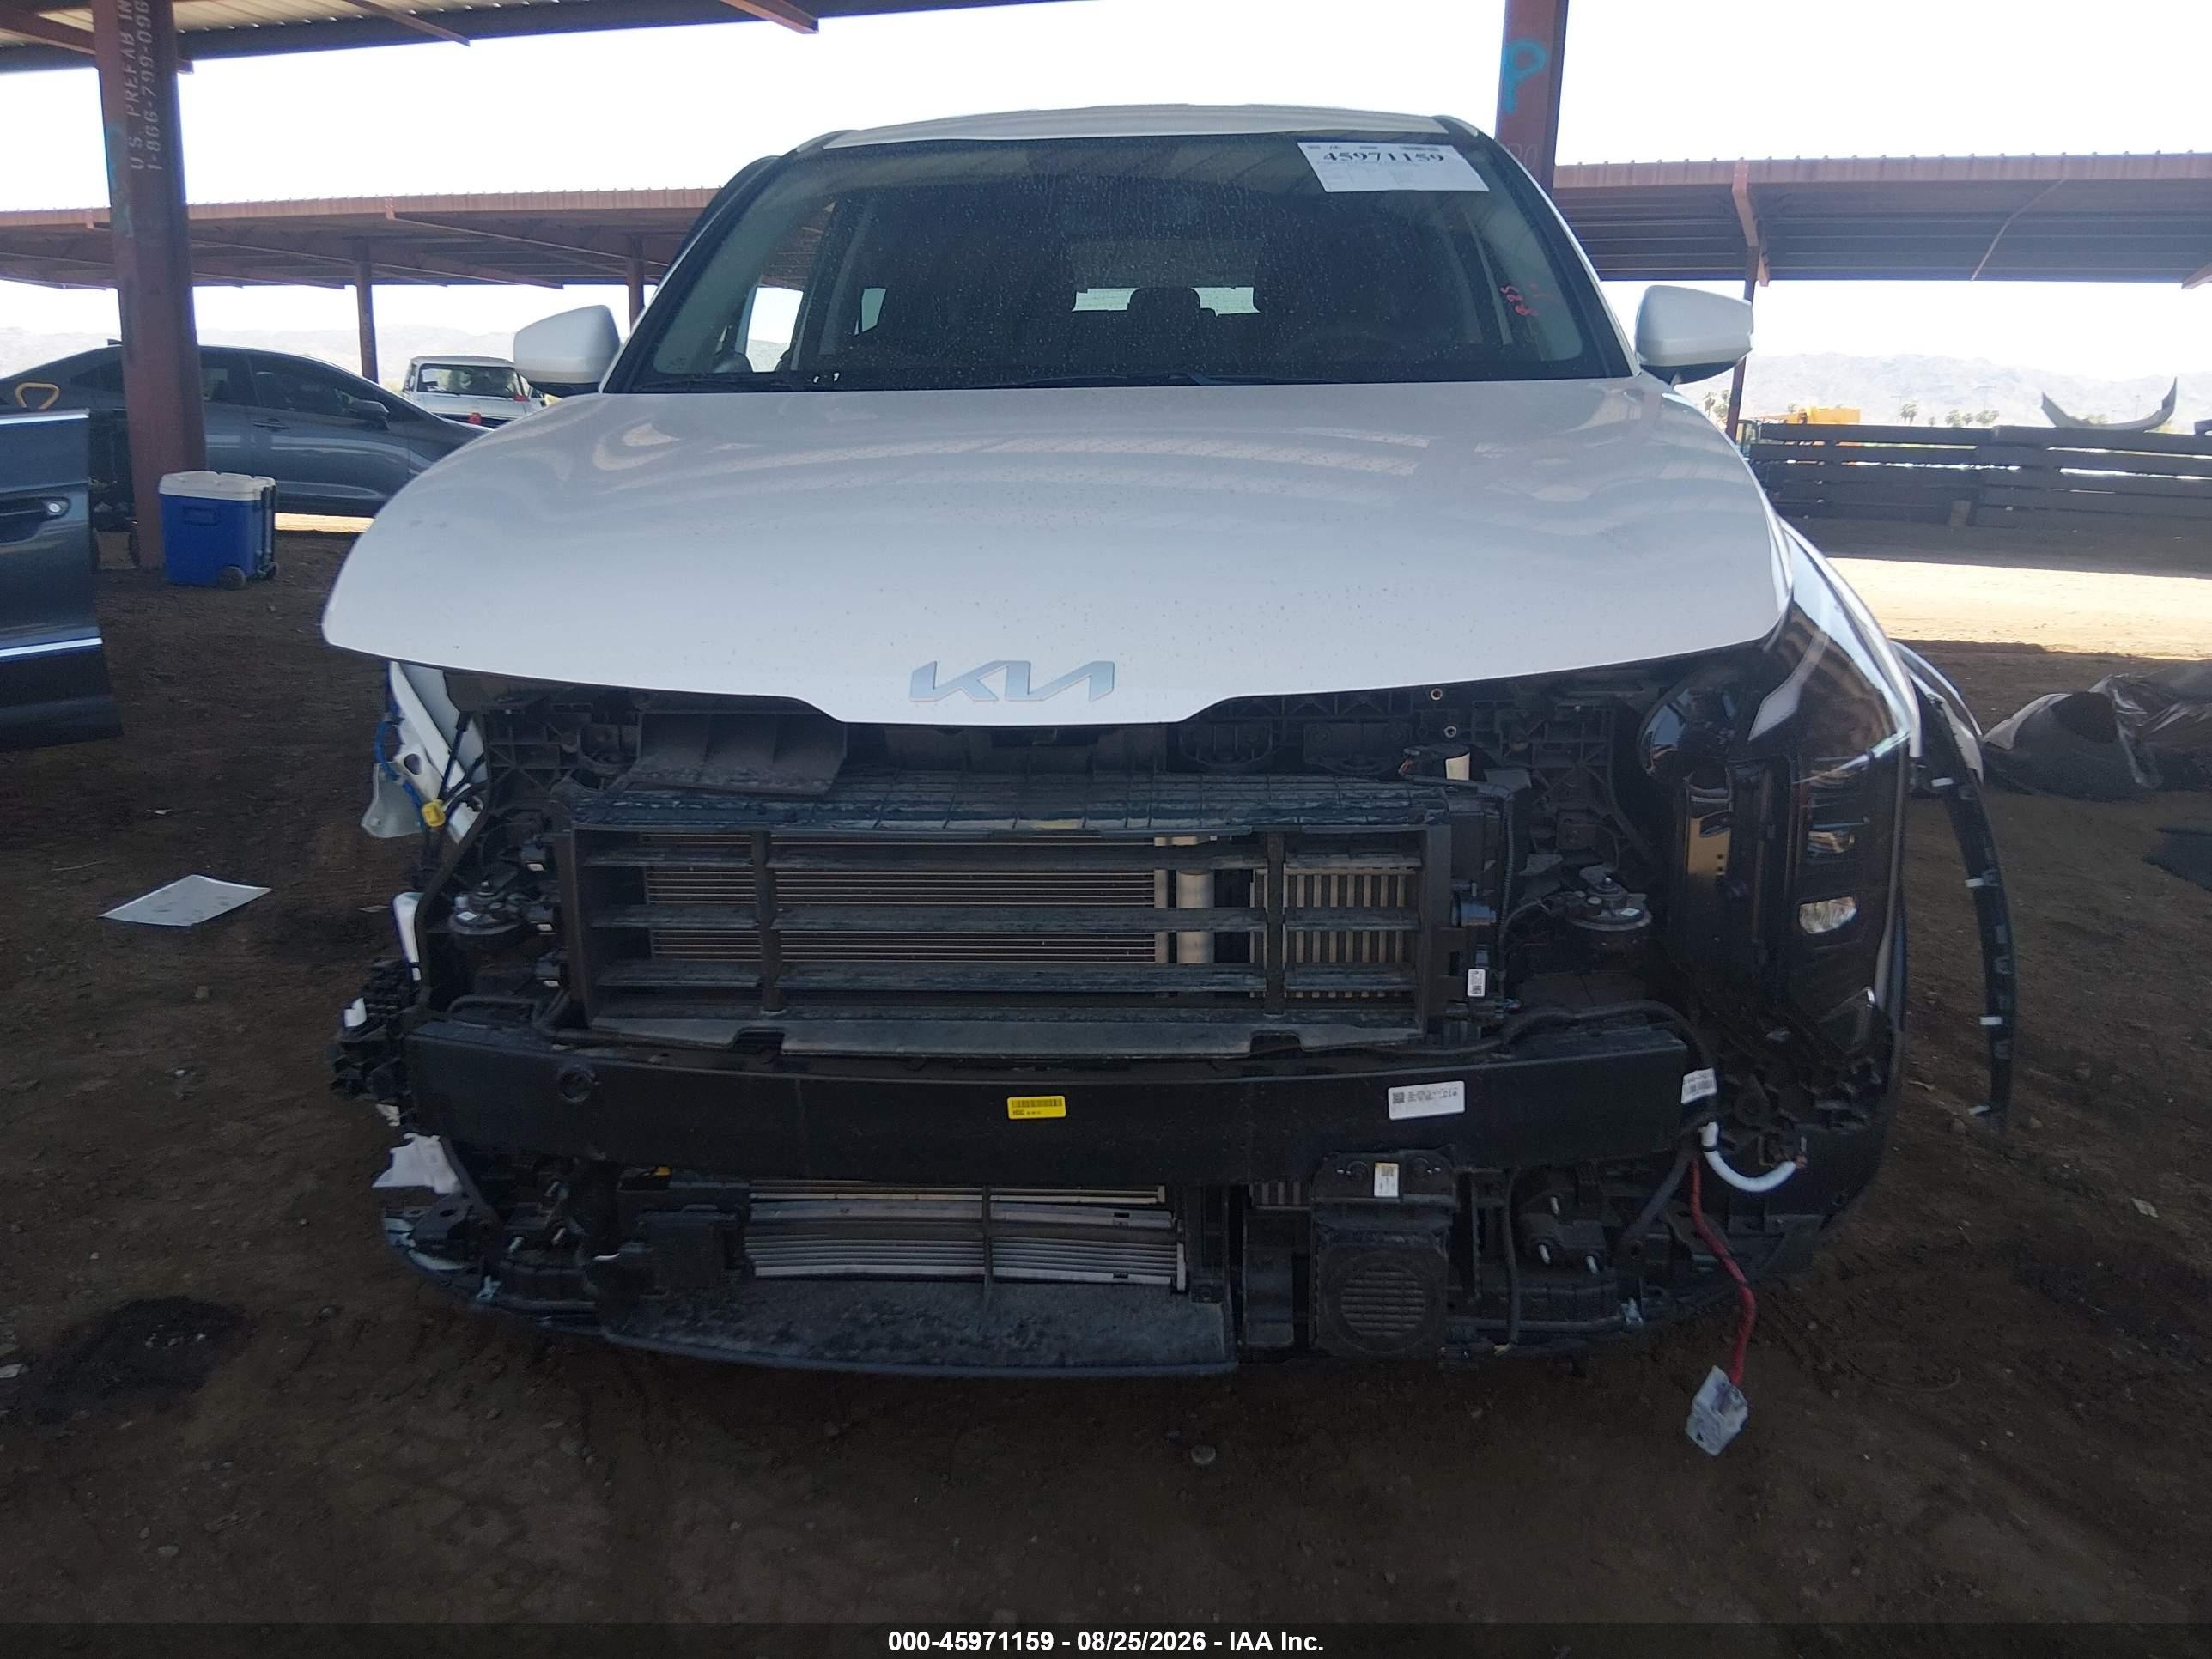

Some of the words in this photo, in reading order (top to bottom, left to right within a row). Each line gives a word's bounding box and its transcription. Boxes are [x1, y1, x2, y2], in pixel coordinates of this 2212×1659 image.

[120, 31, 140, 117] PREFAB
[1503, 37, 1551, 115] P
[1323, 152, 1444, 162] 45971159
